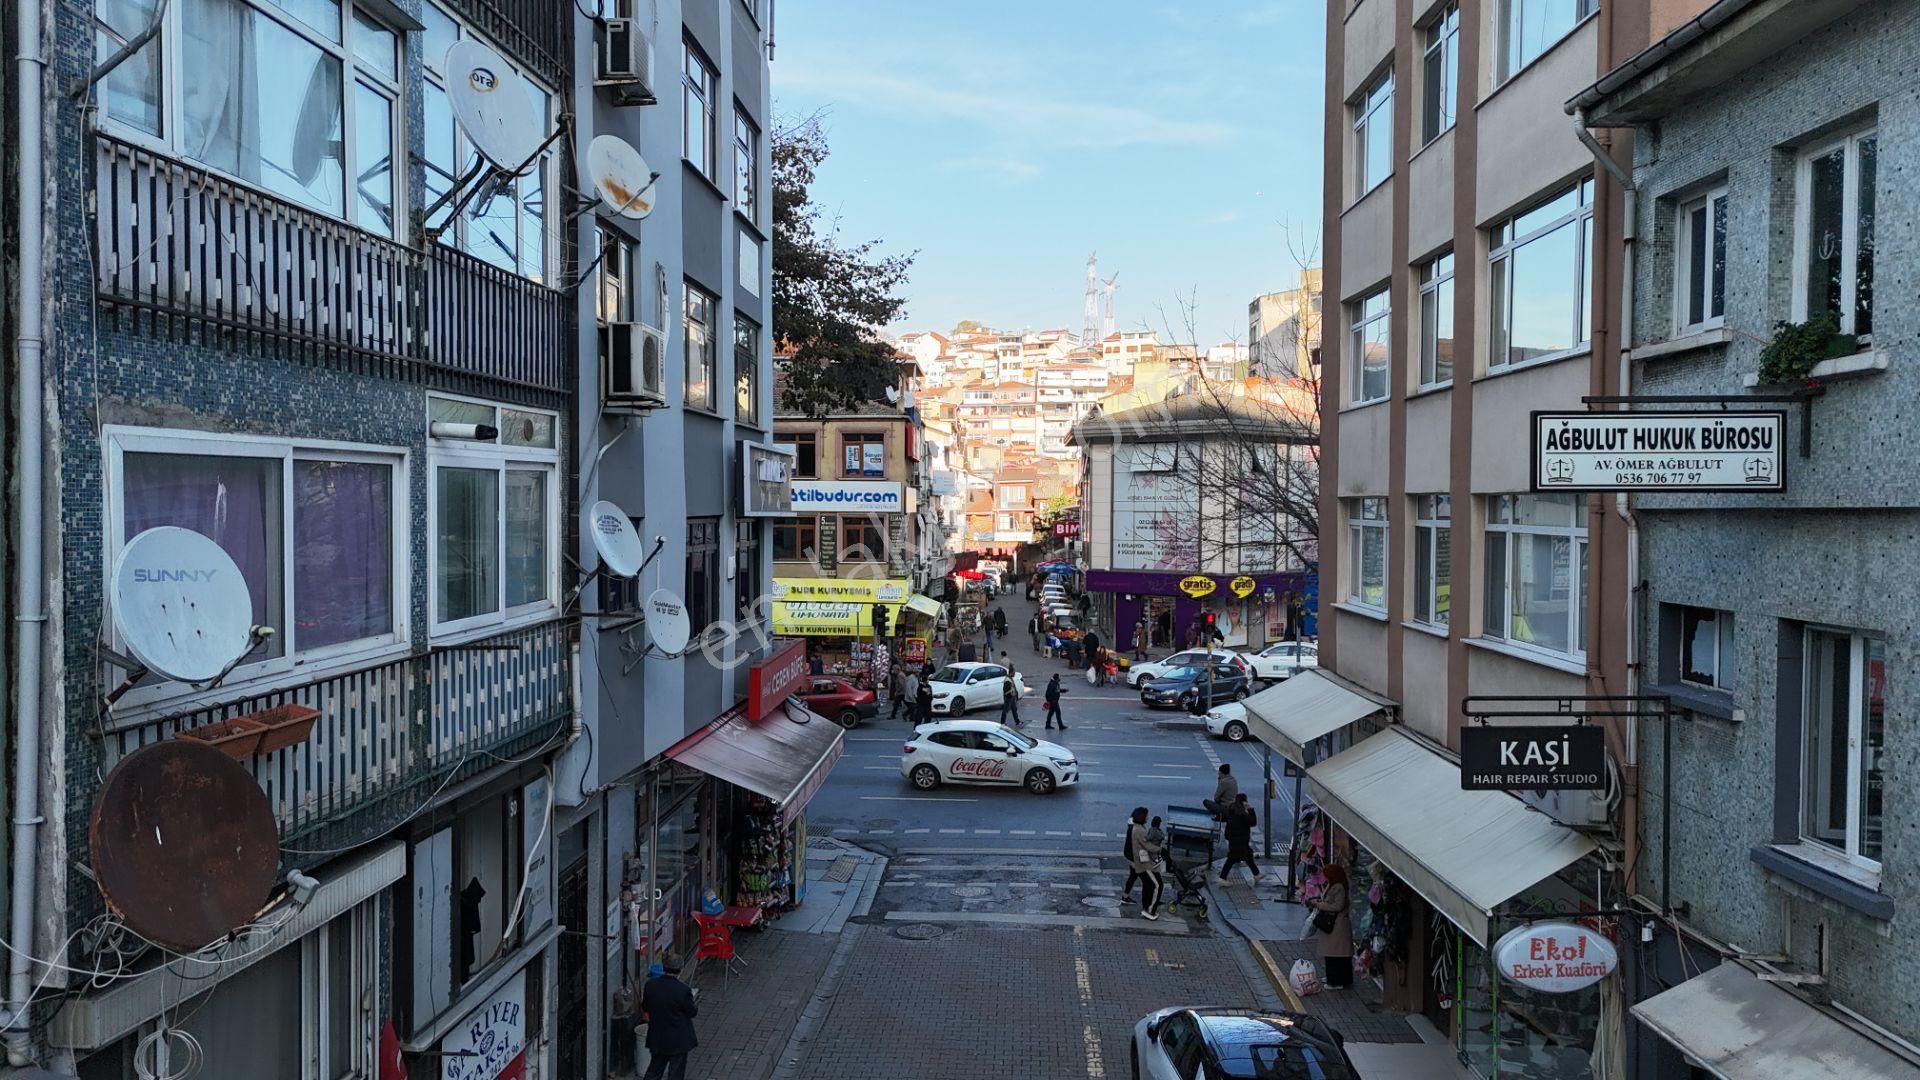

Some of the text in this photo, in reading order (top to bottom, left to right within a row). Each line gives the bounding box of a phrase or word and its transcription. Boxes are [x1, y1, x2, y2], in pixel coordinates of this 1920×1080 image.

[1546, 421, 1773, 450] AĞBULUT HUKUK BÜROSU
[1594, 457, 1723, 471] AV. ÖMER AĞBULUT
[1615, 473, 1702, 484] 0536 706 77 97
[1056, 521, 1080, 534] BİM
[134, 569, 217, 582] SUNNY
[791, 586, 815, 594] SUDE
[818, 585, 872, 597] KURUYEMİŞ
[1183, 578, 1213, 591] gratis
[806, 625, 851, 634] KURUYEMİŞ
[1500, 733, 1570, 772] KAŞİ
[1472, 774, 1598, 785] HAIR REPAIR STUDIO
[1512, 961, 1607, 979] Erkek Kuaförü
